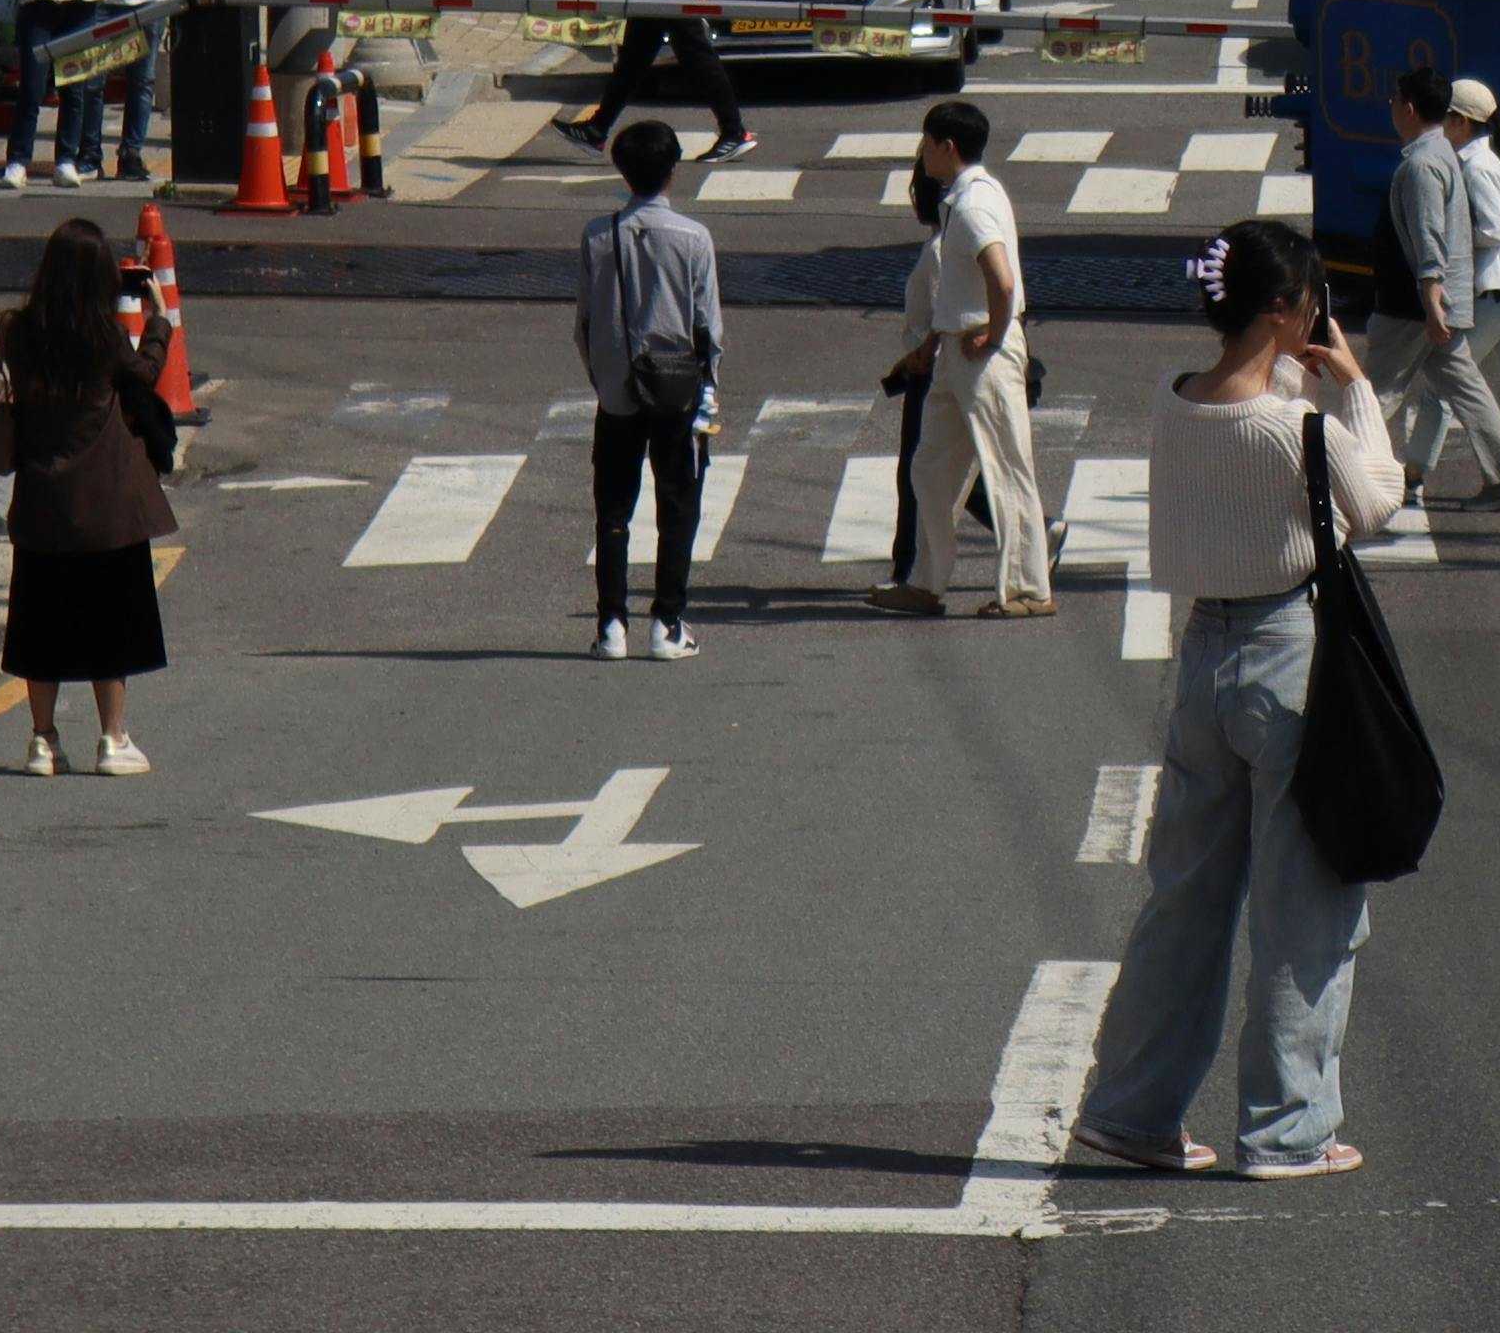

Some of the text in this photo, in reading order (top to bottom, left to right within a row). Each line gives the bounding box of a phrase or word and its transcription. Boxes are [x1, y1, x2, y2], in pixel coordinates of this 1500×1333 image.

[364, 14, 433, 33] 일단정지
[838, 27, 906, 50] 일단정지
[1067, 39, 1138, 61] 일단정지
